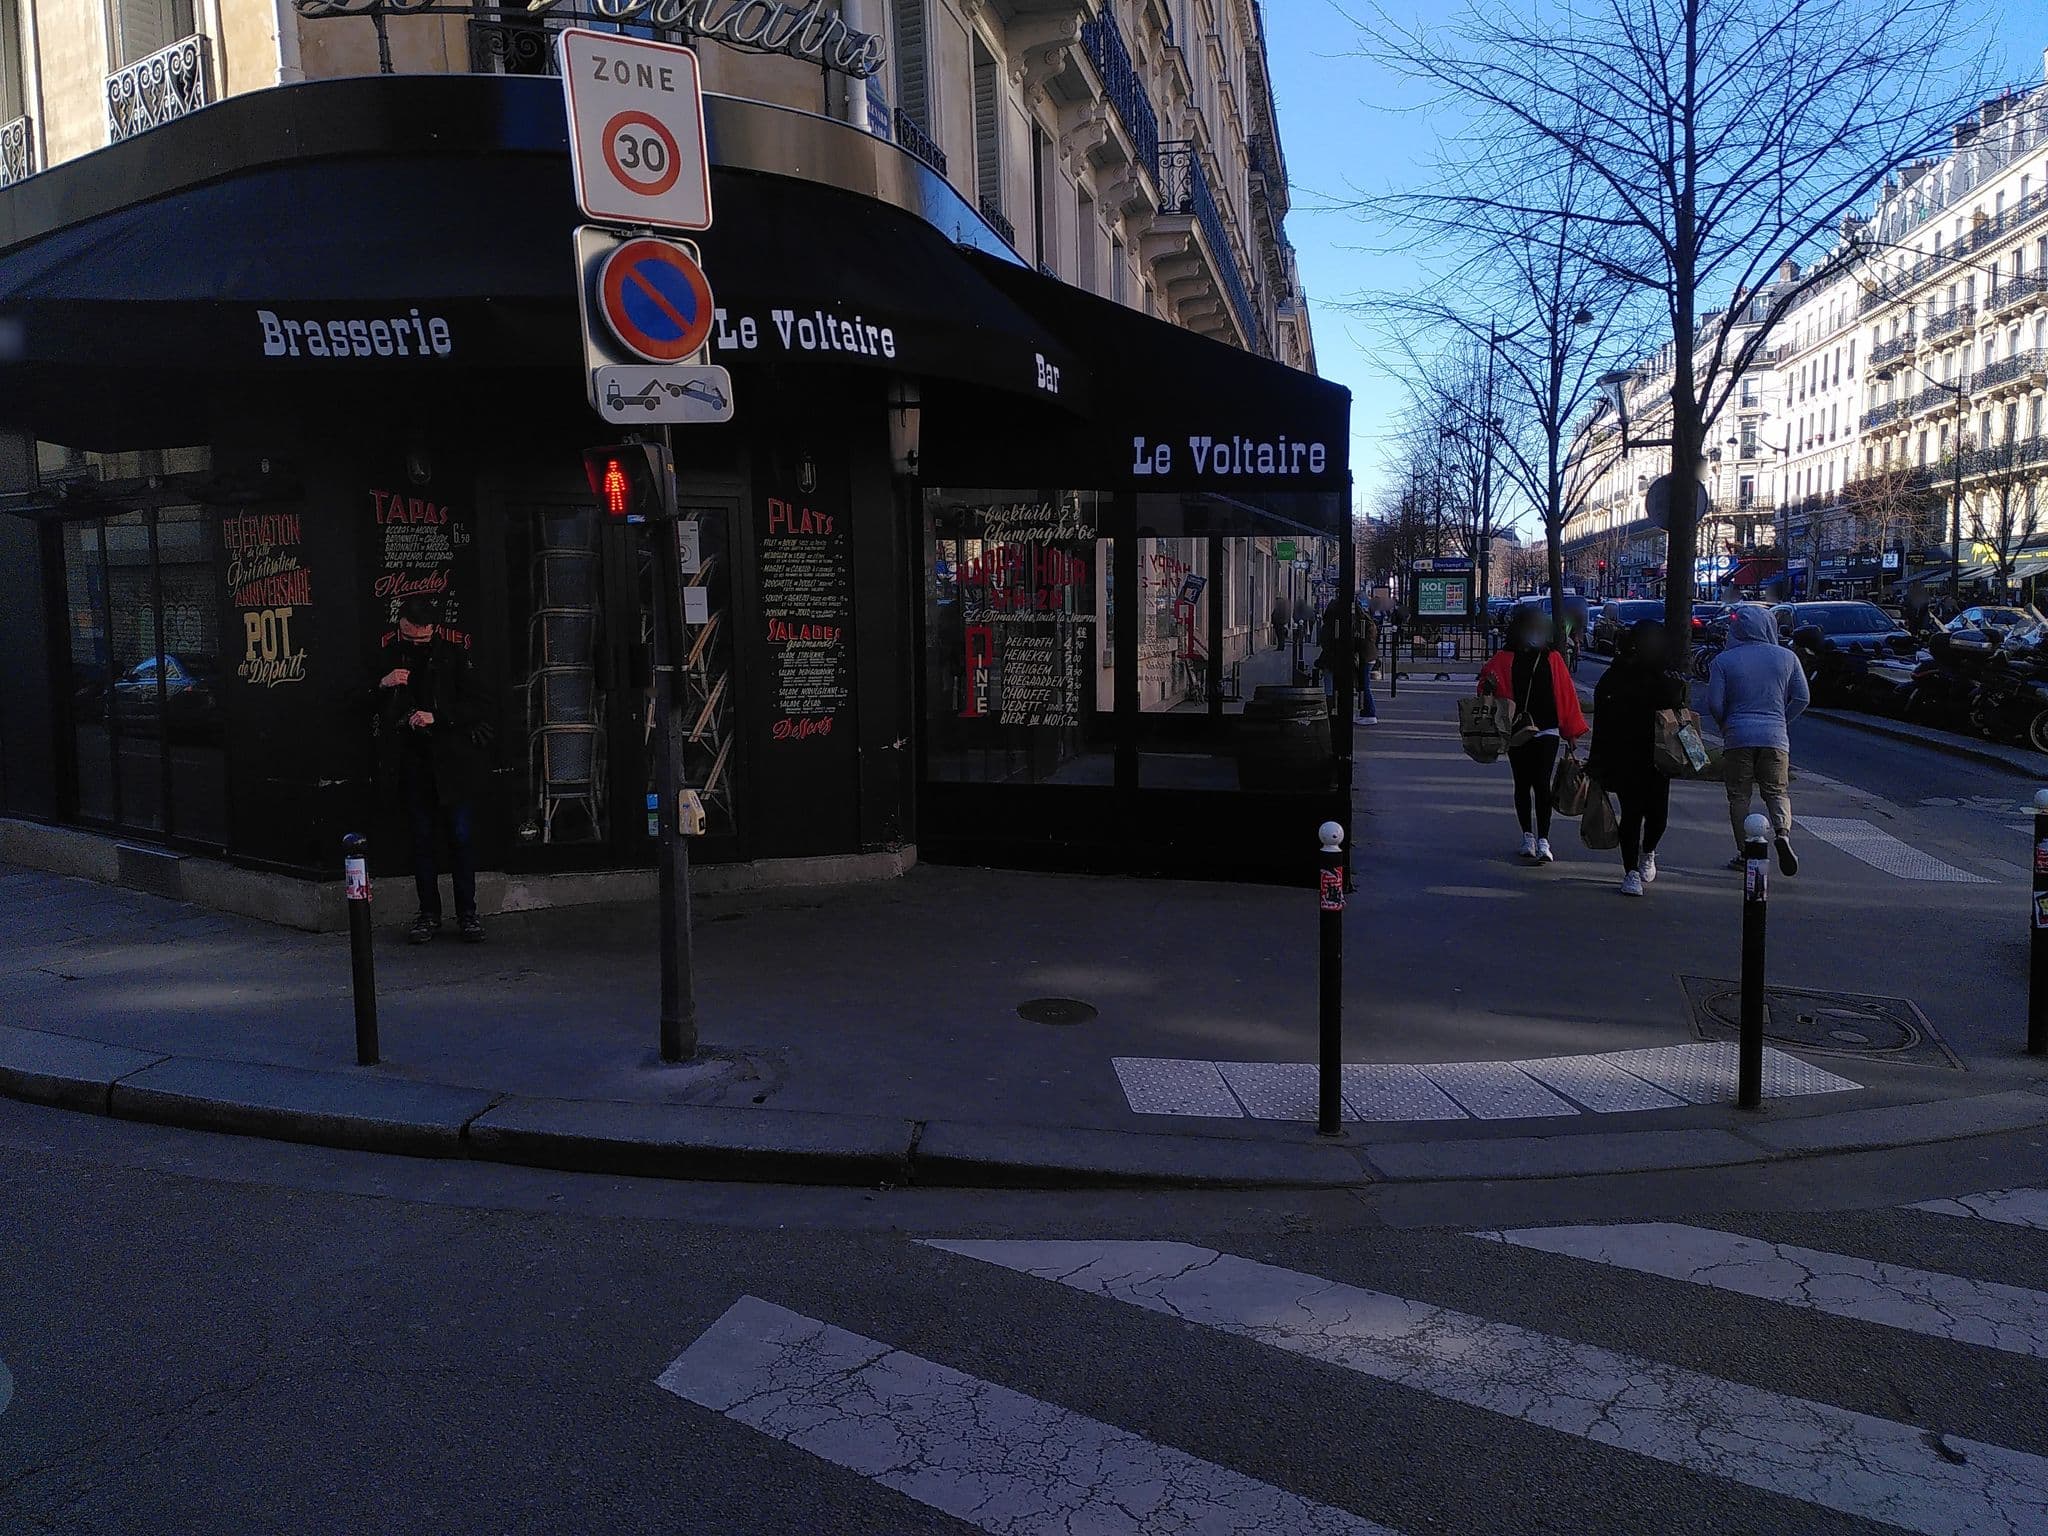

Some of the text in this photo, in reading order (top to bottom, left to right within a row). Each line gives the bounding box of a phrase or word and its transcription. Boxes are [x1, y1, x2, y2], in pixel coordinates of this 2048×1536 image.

[592, 56, 675, 92] ZONE
[619, 133, 665, 172] 30
[257, 308, 451, 357] Brasserie
[715, 308, 896, 358] Le Voltaire
[1034, 352, 1060, 394] Bar
[1132, 435, 1326, 475] Le Voltaire
[983, 523, 1074, 546] Champagne
[244, 607, 293, 660] POT
[767, 618, 843, 641] SALADES
[1005, 636, 1054, 648] PELFORTH
[1003, 649, 1053, 662] HEINEKEN
[1002, 687, 1052, 701] CHOUFFE
